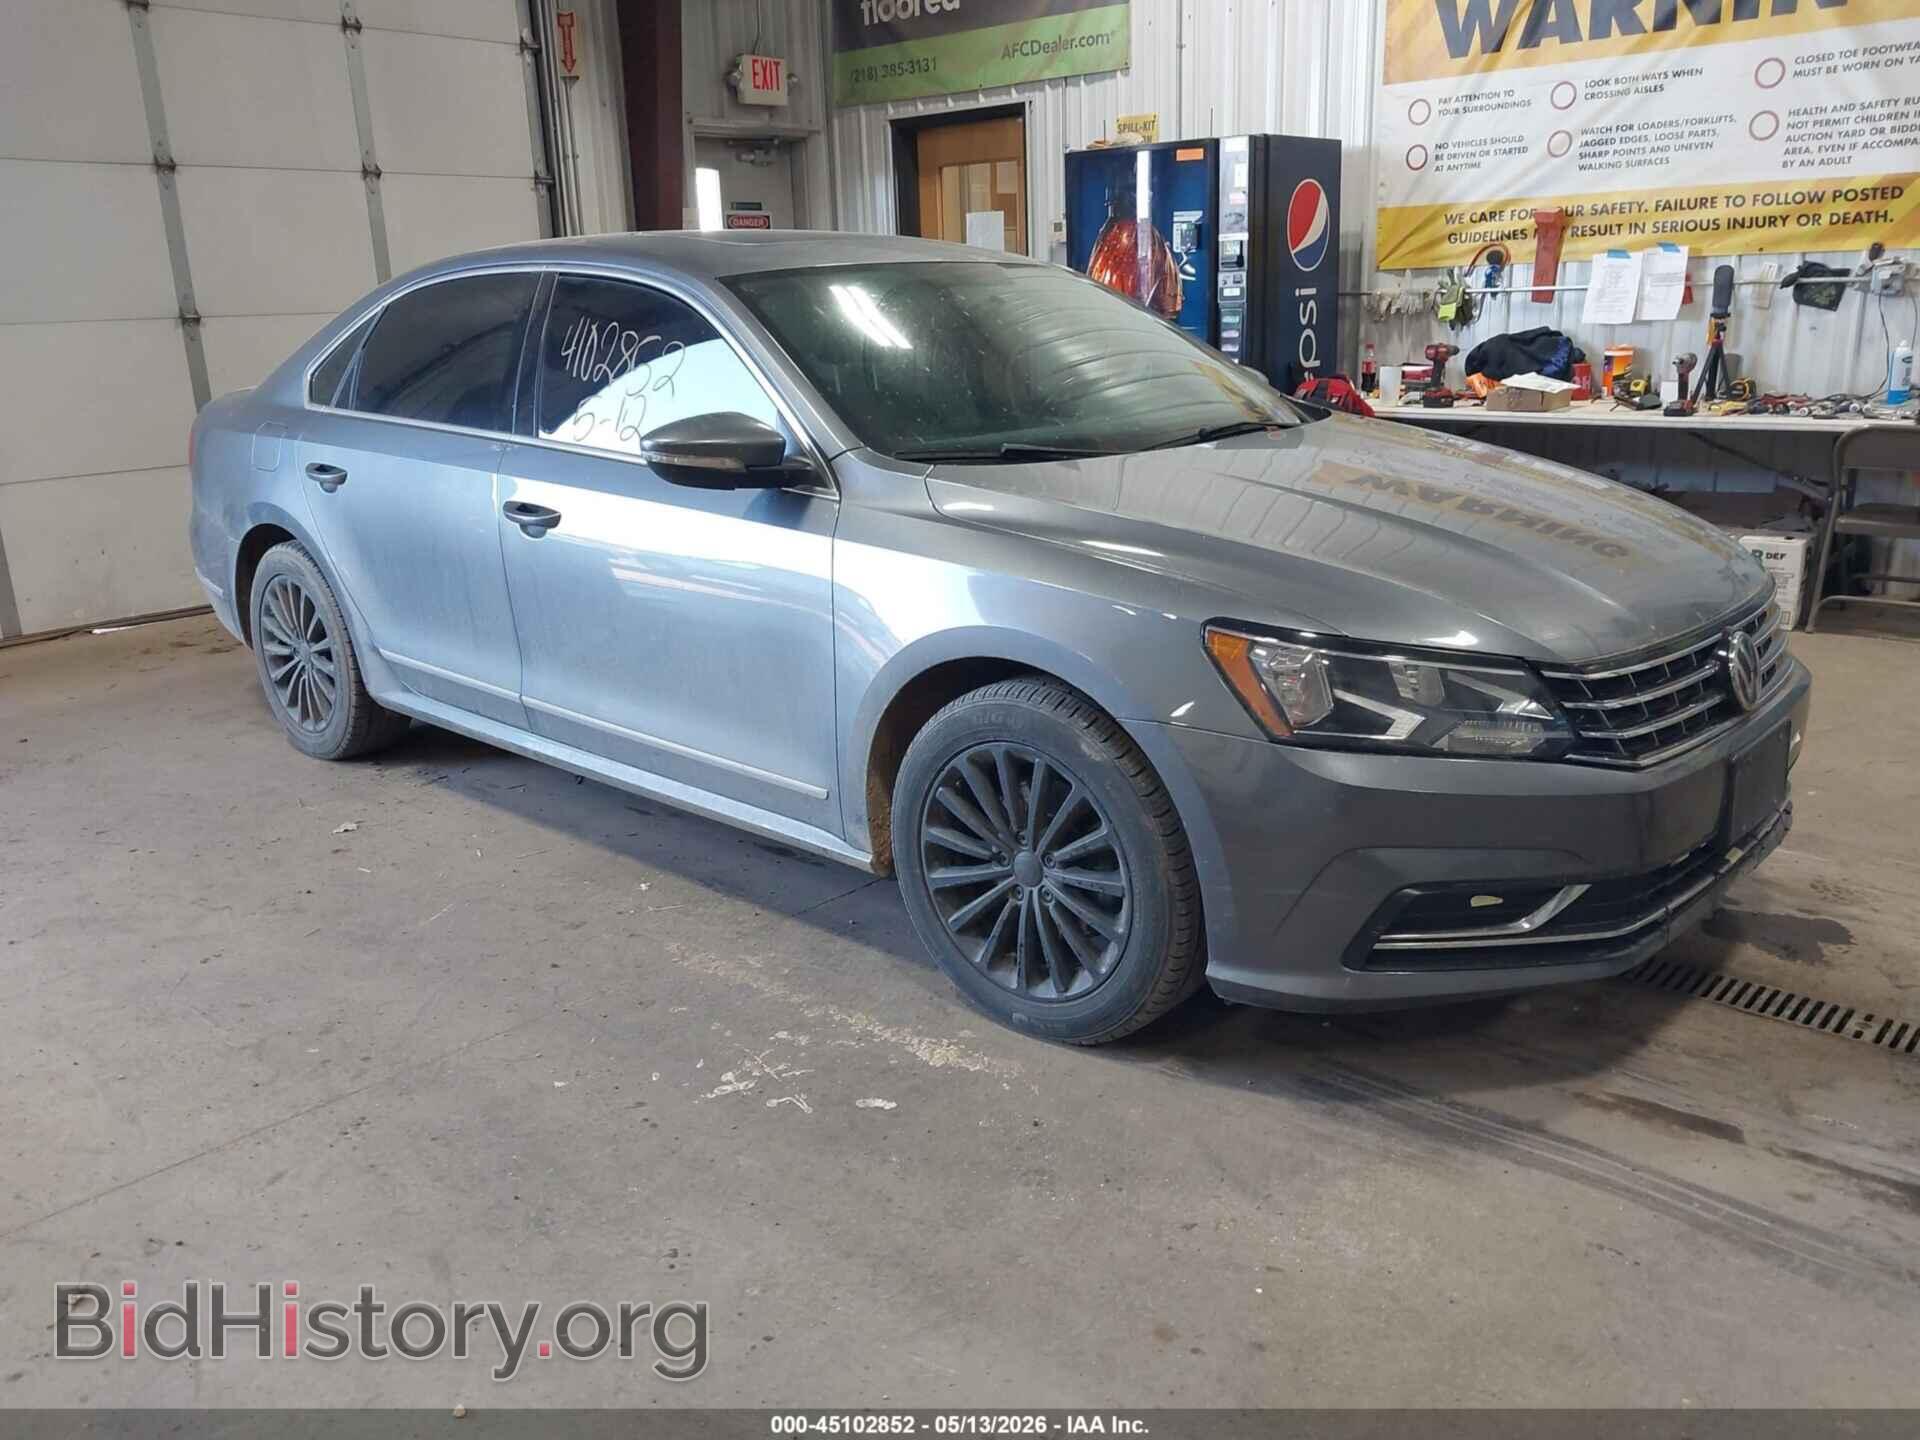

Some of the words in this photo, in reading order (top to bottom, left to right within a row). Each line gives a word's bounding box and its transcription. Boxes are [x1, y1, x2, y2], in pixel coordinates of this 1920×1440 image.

[1794, 52, 1836, 65] CLOSED
[1839, 49, 1858, 59] TOE
[751, 58, 781, 91] EXIT
[1793, 66, 1823, 78] MUST
[1825, 65, 1838, 74] BE
[1842, 60, 1881, 72] WORN
[1884, 57, 1904, 68] ON
[1585, 78, 1610, 88] LOOK
[1614, 75, 1639, 85] BOTH
[1641, 70, 1668, 82] WAYS
[1672, 67, 1703, 78] WHEN
[1438, 97, 1452, 106] PAY
[1454, 91, 1501, 104] ATTENTION
[1503, 89, 1515, 97] TO
[1584, 88, 1631, 101] CROSSING
[1633, 84, 1664, 94] AISLES
[1438, 107, 1460, 117] YOUR
[1462, 99, 1532, 114] SURROUNDINGS
[1788, 106, 1828, 117] HEALTH
[1831, 103, 1857, 113] AND
[1859, 97, 1901, 110] SAFETY
[1116, 119, 1156, 134] SPILL-KIT
[1786, 120, 1809, 130] NOT
[1812, 117, 1851, 128] PERMIT
[1854, 111, 1910, 124] CHILDREN
[1581, 126, 1613, 136] WATCH
[1615, 123, 1634, 133] FOR
[1785, 131, 1833, 143] AUCTION
[1838, 129, 1865, 139] YARD
[1869, 127, 1887, 136] OR
[1434, 141, 1449, 150] NO
[1451, 138, 1488, 148] VEHICLES
[1490, 135, 1524, 144] SHOULD
[1579, 137, 1616, 148] JAGGED
[1654, 130, 1684, 142] LOOSE
[1817, 143, 1846, 153] EVEN
[1849, 142, 1858, 152] IF
[1434, 152, 1444, 161] BE
[1447, 150, 1476, 160] DRIVEN
[1478, 149, 1490, 157] OR
[1493, 146, 1528, 156] STARTED
[1578, 150, 1610, 160] SHARP
[1613, 146, 1646, 157] POINTS
[1650, 144, 1671, 153] AND
[1673, 141, 1713, 152] UNEVEN
[1434, 164, 1444, 172] AT
[1446, 162, 1481, 172] ANYTIME
[1578, 160, 1622, 172] WALKING
[1625, 157, 1670, 168] SURFACES
[1782, 159, 1795, 168] BY
[1799, 158, 1815, 168] AN
[1818, 155, 1852, 166] ADULT
[1444, 212, 1465, 225] WE
[1469, 209, 1505, 223] CARE
[1589, 201, 1648, 216] SAFETY.
[1654, 196, 1718, 212] FAILURE
[1724, 194, 1746, 207] TO
[1752, 190, 1827, 207] FOLLOW
[1831, 185, 1904, 202] POSTED
[733, 216, 763, 226] DANGER
[1447, 231, 1528, 244] GUIDELINES
[1570, 222, 1626, 238] RESULT
[1629, 220, 1646, 234] IN
[1652, 218, 1721, 234] SERIOUS
[1726, 214, 1791, 230] INJURY
[1796, 212, 1822, 226] OR
[1828, 209, 1894, 226] DEATH.
